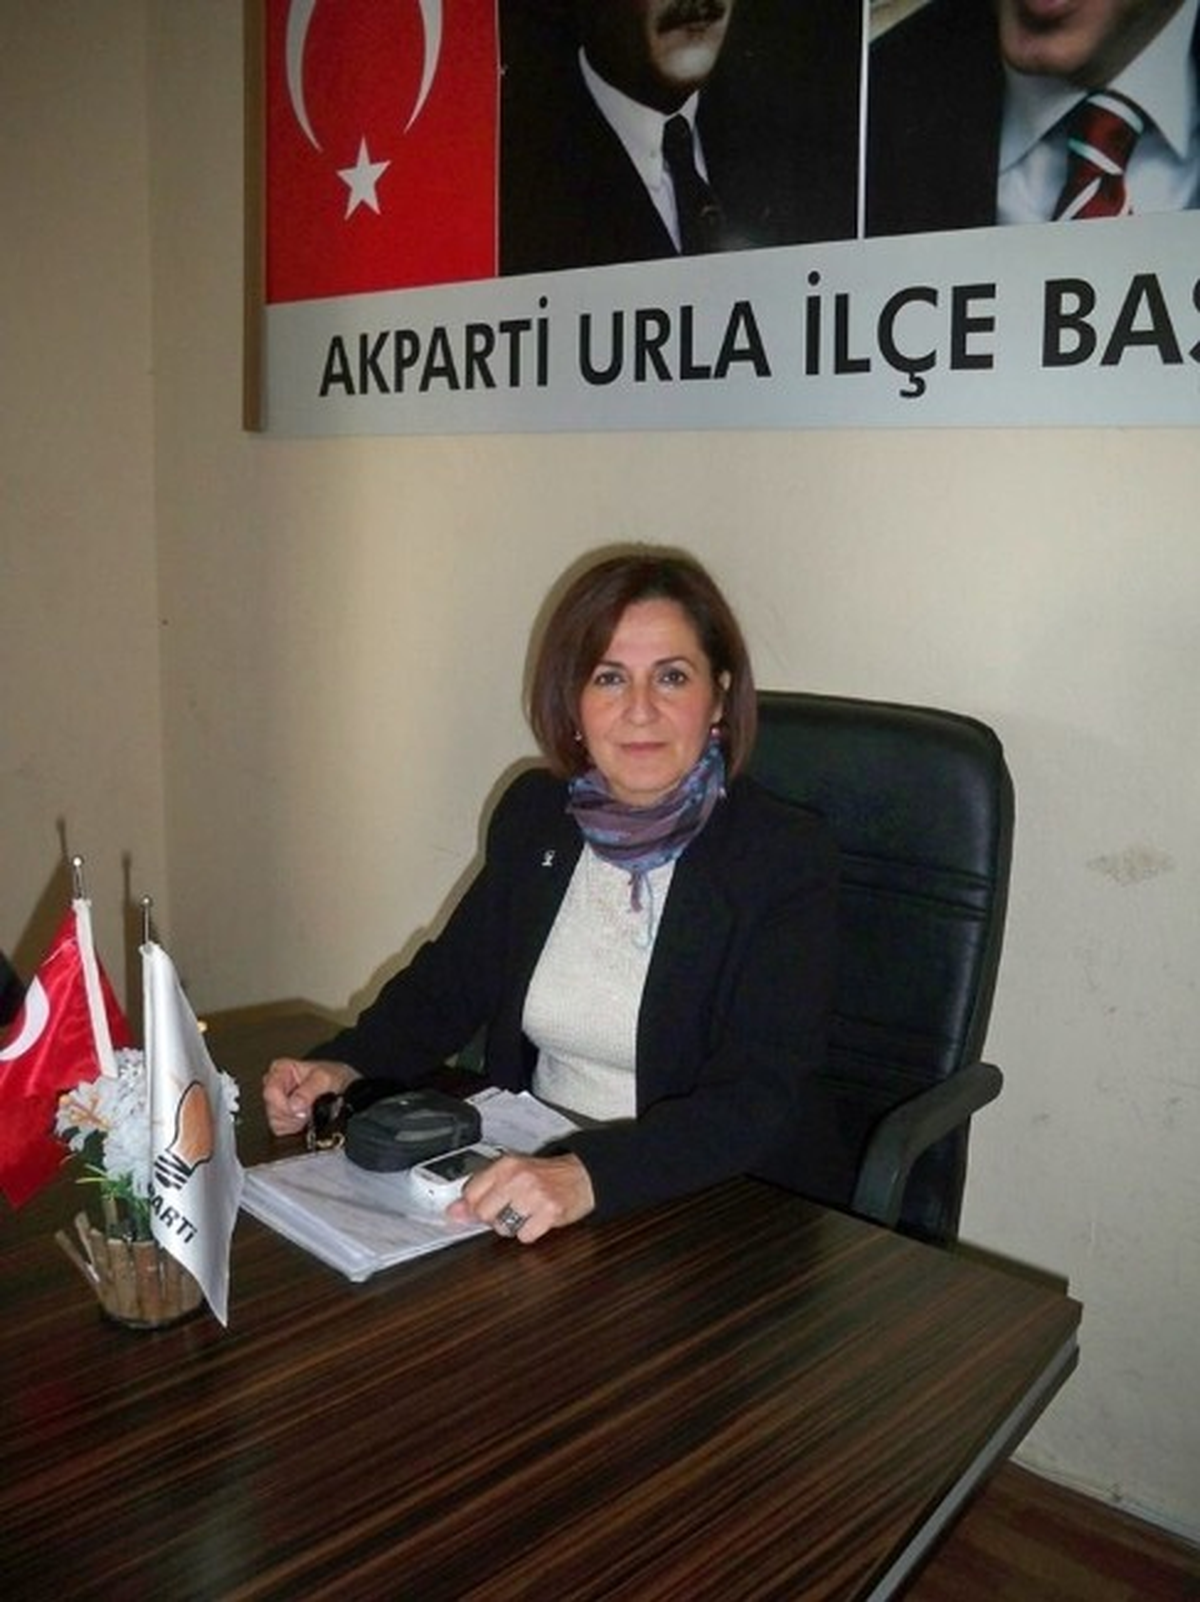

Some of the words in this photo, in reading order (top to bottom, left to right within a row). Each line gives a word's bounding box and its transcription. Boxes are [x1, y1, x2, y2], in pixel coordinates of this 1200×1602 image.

[318, 295, 549, 398] AKPARTİ
[579, 300, 772, 386] URLA
[805, 270, 997, 399] İLÇE
[1042, 272, 1200, 368] BA
